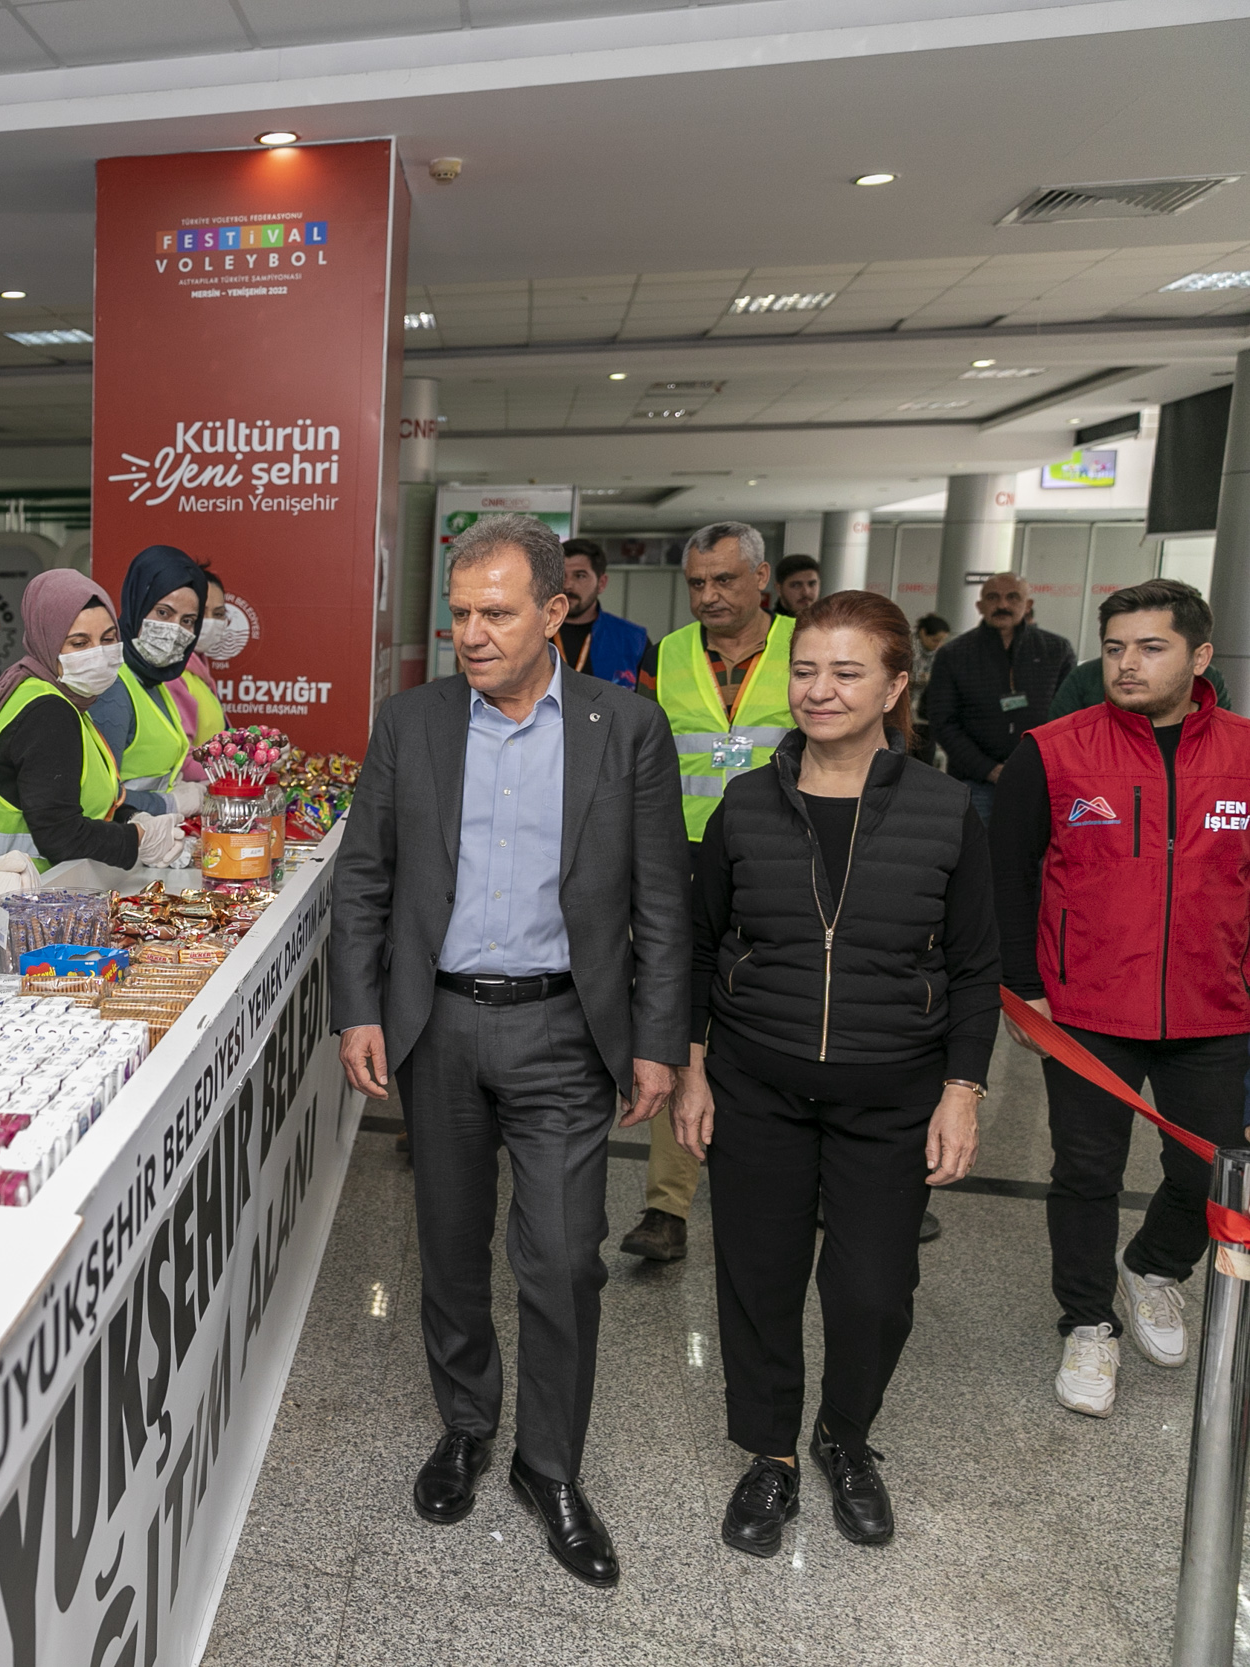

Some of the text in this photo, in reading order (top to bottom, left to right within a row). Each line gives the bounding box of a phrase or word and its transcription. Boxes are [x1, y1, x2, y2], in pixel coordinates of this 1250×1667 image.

[211, 215, 248, 224] VOLEYBOL
[250, 212, 303, 222] FEDERASYONU
[155, 250, 328, 273] VOLEYBOL
[191, 289, 221, 299] MERSİN
[227, 286, 267, 298] YENİŞEHİR
[268, 286, 288, 295] 2022
[176, 418, 340, 453] Kültürün
[146, 446, 338, 506] Yeni şehri
[178, 493, 339, 516] Mersin Yenişehir
[1215, 800, 1247, 815] FEN
[163, 995, 245, 1191] BELEDİYESİ
[248, 950, 284, 1040] YEMEK
[284, 898, 318, 984] DAĞITIM
